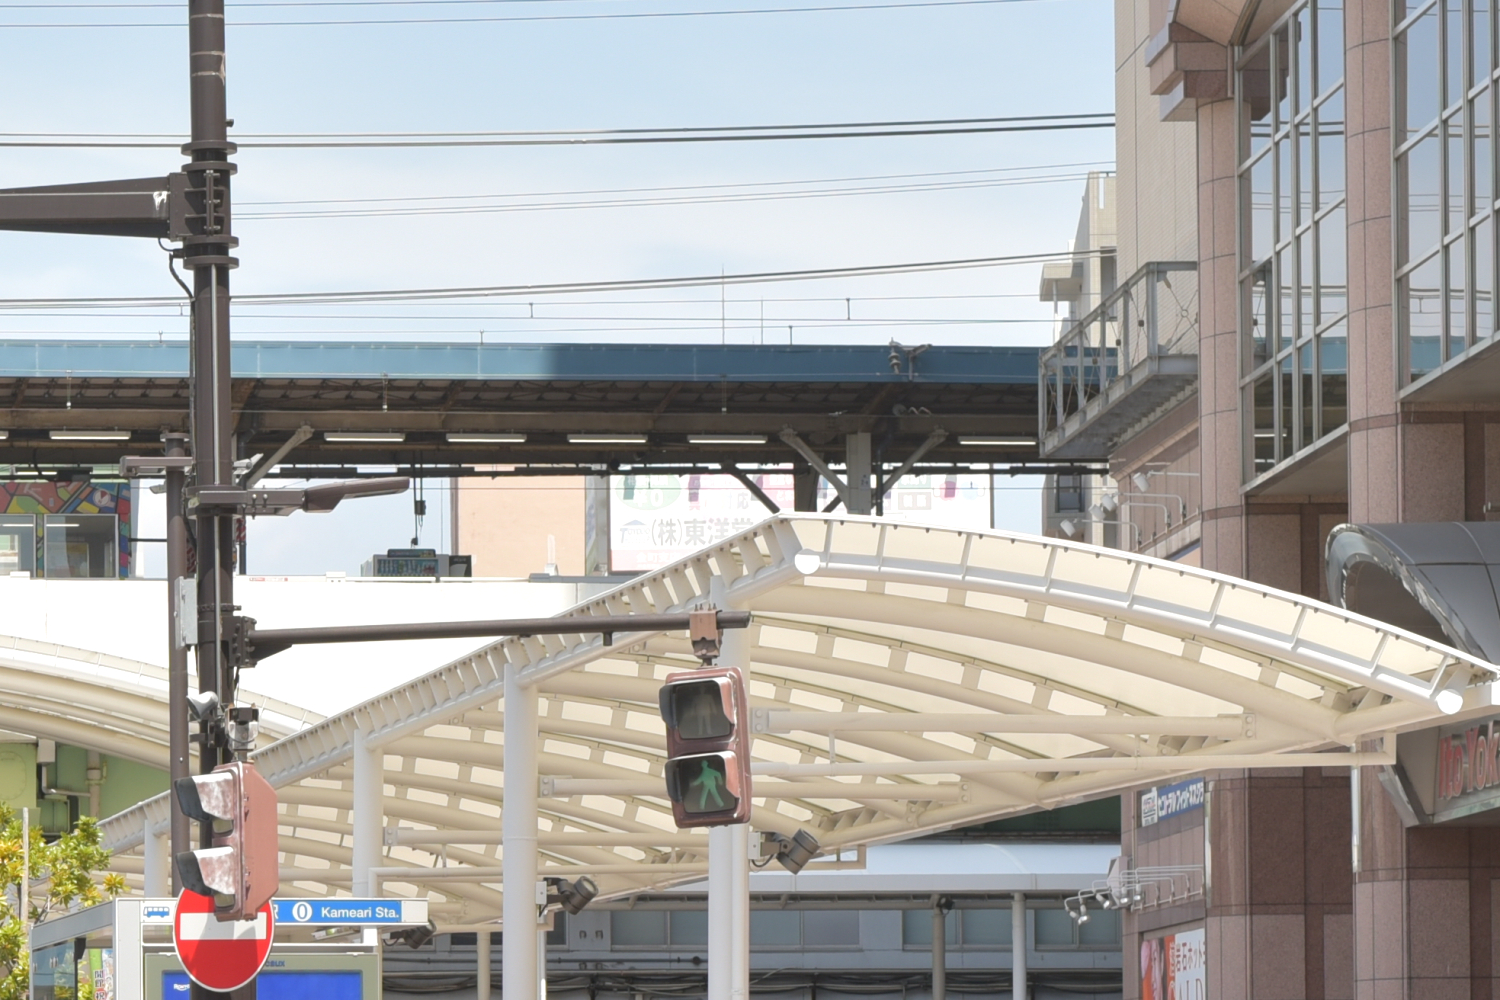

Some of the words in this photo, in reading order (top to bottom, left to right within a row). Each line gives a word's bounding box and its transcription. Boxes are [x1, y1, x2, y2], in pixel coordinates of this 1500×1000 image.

[1464, 720, 1500, 793] Yok
[321, 906, 372, 918] Kameari
[375, 907, 400, 918] Sta.
